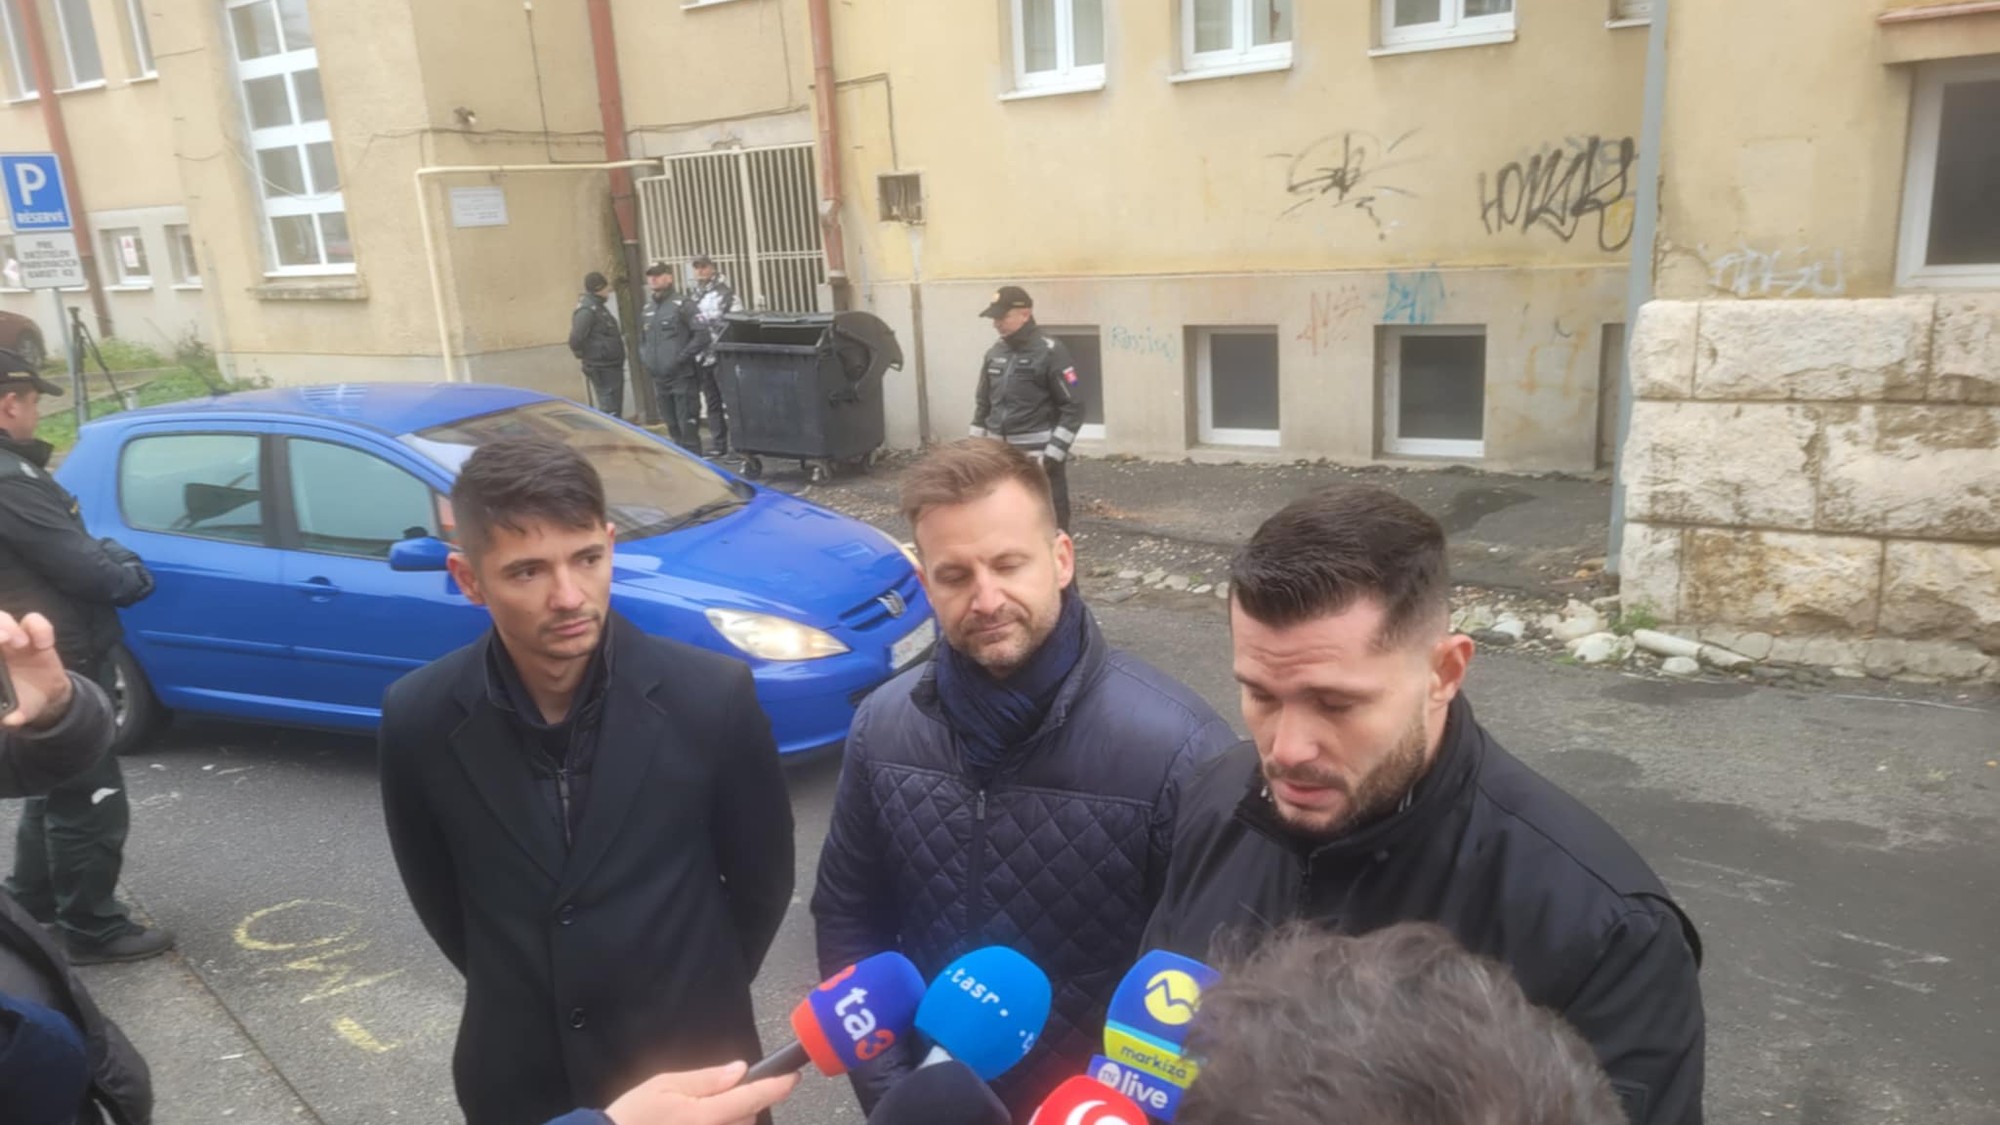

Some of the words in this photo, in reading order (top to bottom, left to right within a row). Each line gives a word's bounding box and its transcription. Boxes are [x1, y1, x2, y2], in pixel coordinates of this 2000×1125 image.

[14, 162, 47, 206] P
[834, 986, 895, 1061] ta3
[1120, 1045, 1188, 1079] markiza
[1120, 1070, 1169, 1109] live
